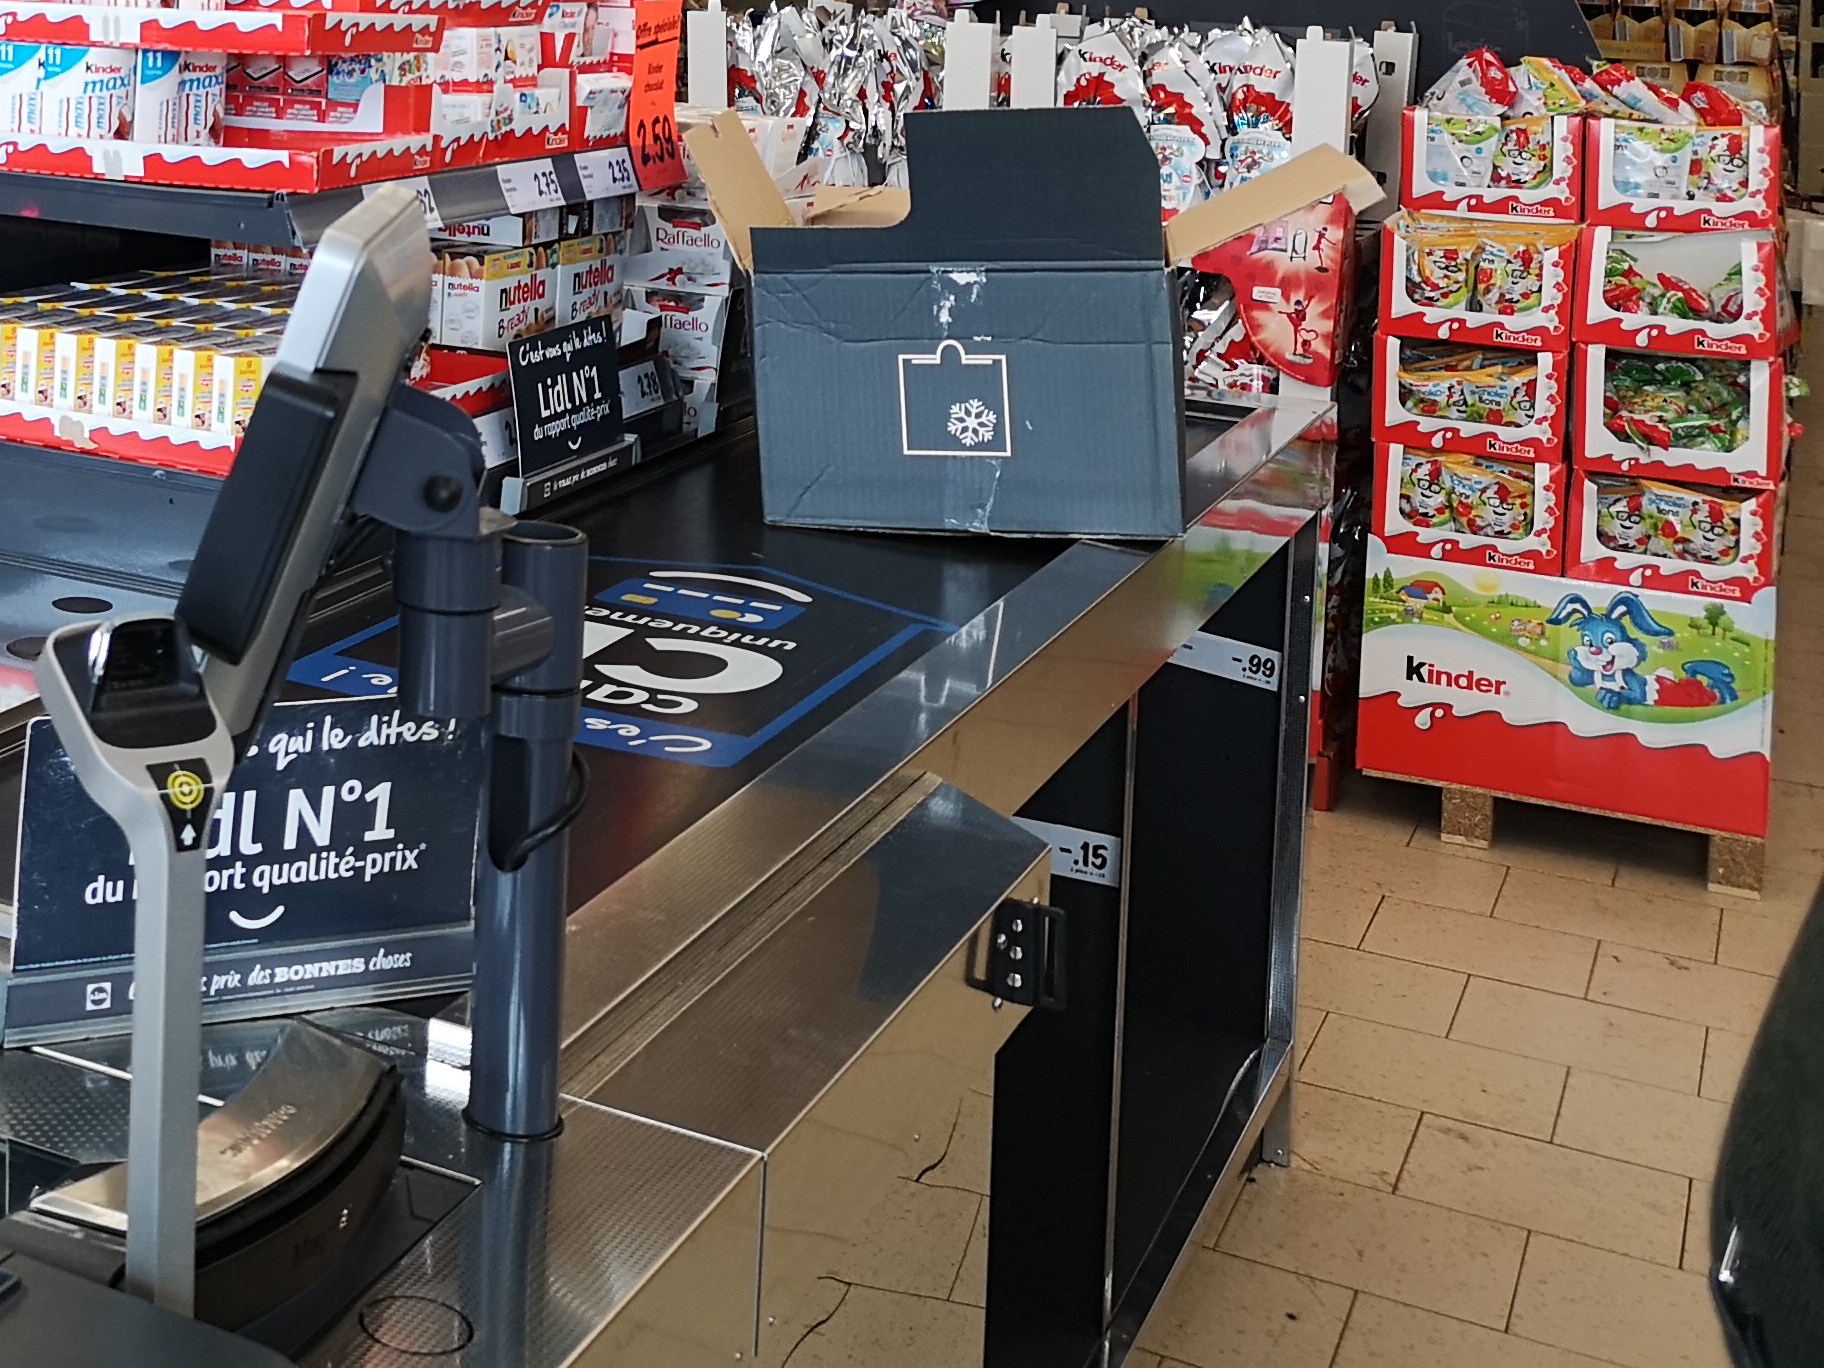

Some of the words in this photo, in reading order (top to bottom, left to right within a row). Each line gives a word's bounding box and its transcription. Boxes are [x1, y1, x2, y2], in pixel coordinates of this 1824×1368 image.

[0, 44, 14, 61] 11
[47, 48, 62, 65] 11
[146, 51, 163, 68] 11
[1078, 48, 1129, 74] Kinder
[637, 115, 676, 168] 2.59
[533, 170, 560, 198] 2.75
[608, 158, 631, 185] 2.35
[1509, 201, 1555, 217] Kinder
[1701, 214, 1750, 232] Kinder
[656, 227, 721, 249] Raffaello
[447, 281, 480, 293] nutella
[572, 258, 615, 296] nutella
[499, 273, 546, 312] nutella
[497, 306, 531, 339] B-ready
[661, 311, 709, 333] ffaello
[1493, 328, 1542, 347] Kinder
[1695, 335, 1747, 355] Kinder
[518, 340, 544, 366] C'est
[545, 343, 562, 360] vous
[537, 372, 573, 418] Lidl
[572, 365, 603, 404] N°1
[533, 422, 544, 441] du
[544, 415, 571, 438] rapport
[1487, 439, 1536, 459] Kinder
[1732, 474, 1775, 490] Kinder
[1487, 551, 1536, 570] Kinder
[1689, 577, 1742, 598] Kinder
[582, 606, 798, 652] uniqueme
[1231, 653, 1276, 679] -.99
[1405, 655, 1507, 696] Kinder
[268, 722, 314, 771] qui
[322, 715, 353, 752] le
[283, 778, 396, 851] N°1
[1059, 841, 1109, 871] -.15
[84, 875, 125, 905] du
[248, 963, 273, 989] des
[273, 957, 366, 982] BONNES
[368, 947, 413, 973] choses
